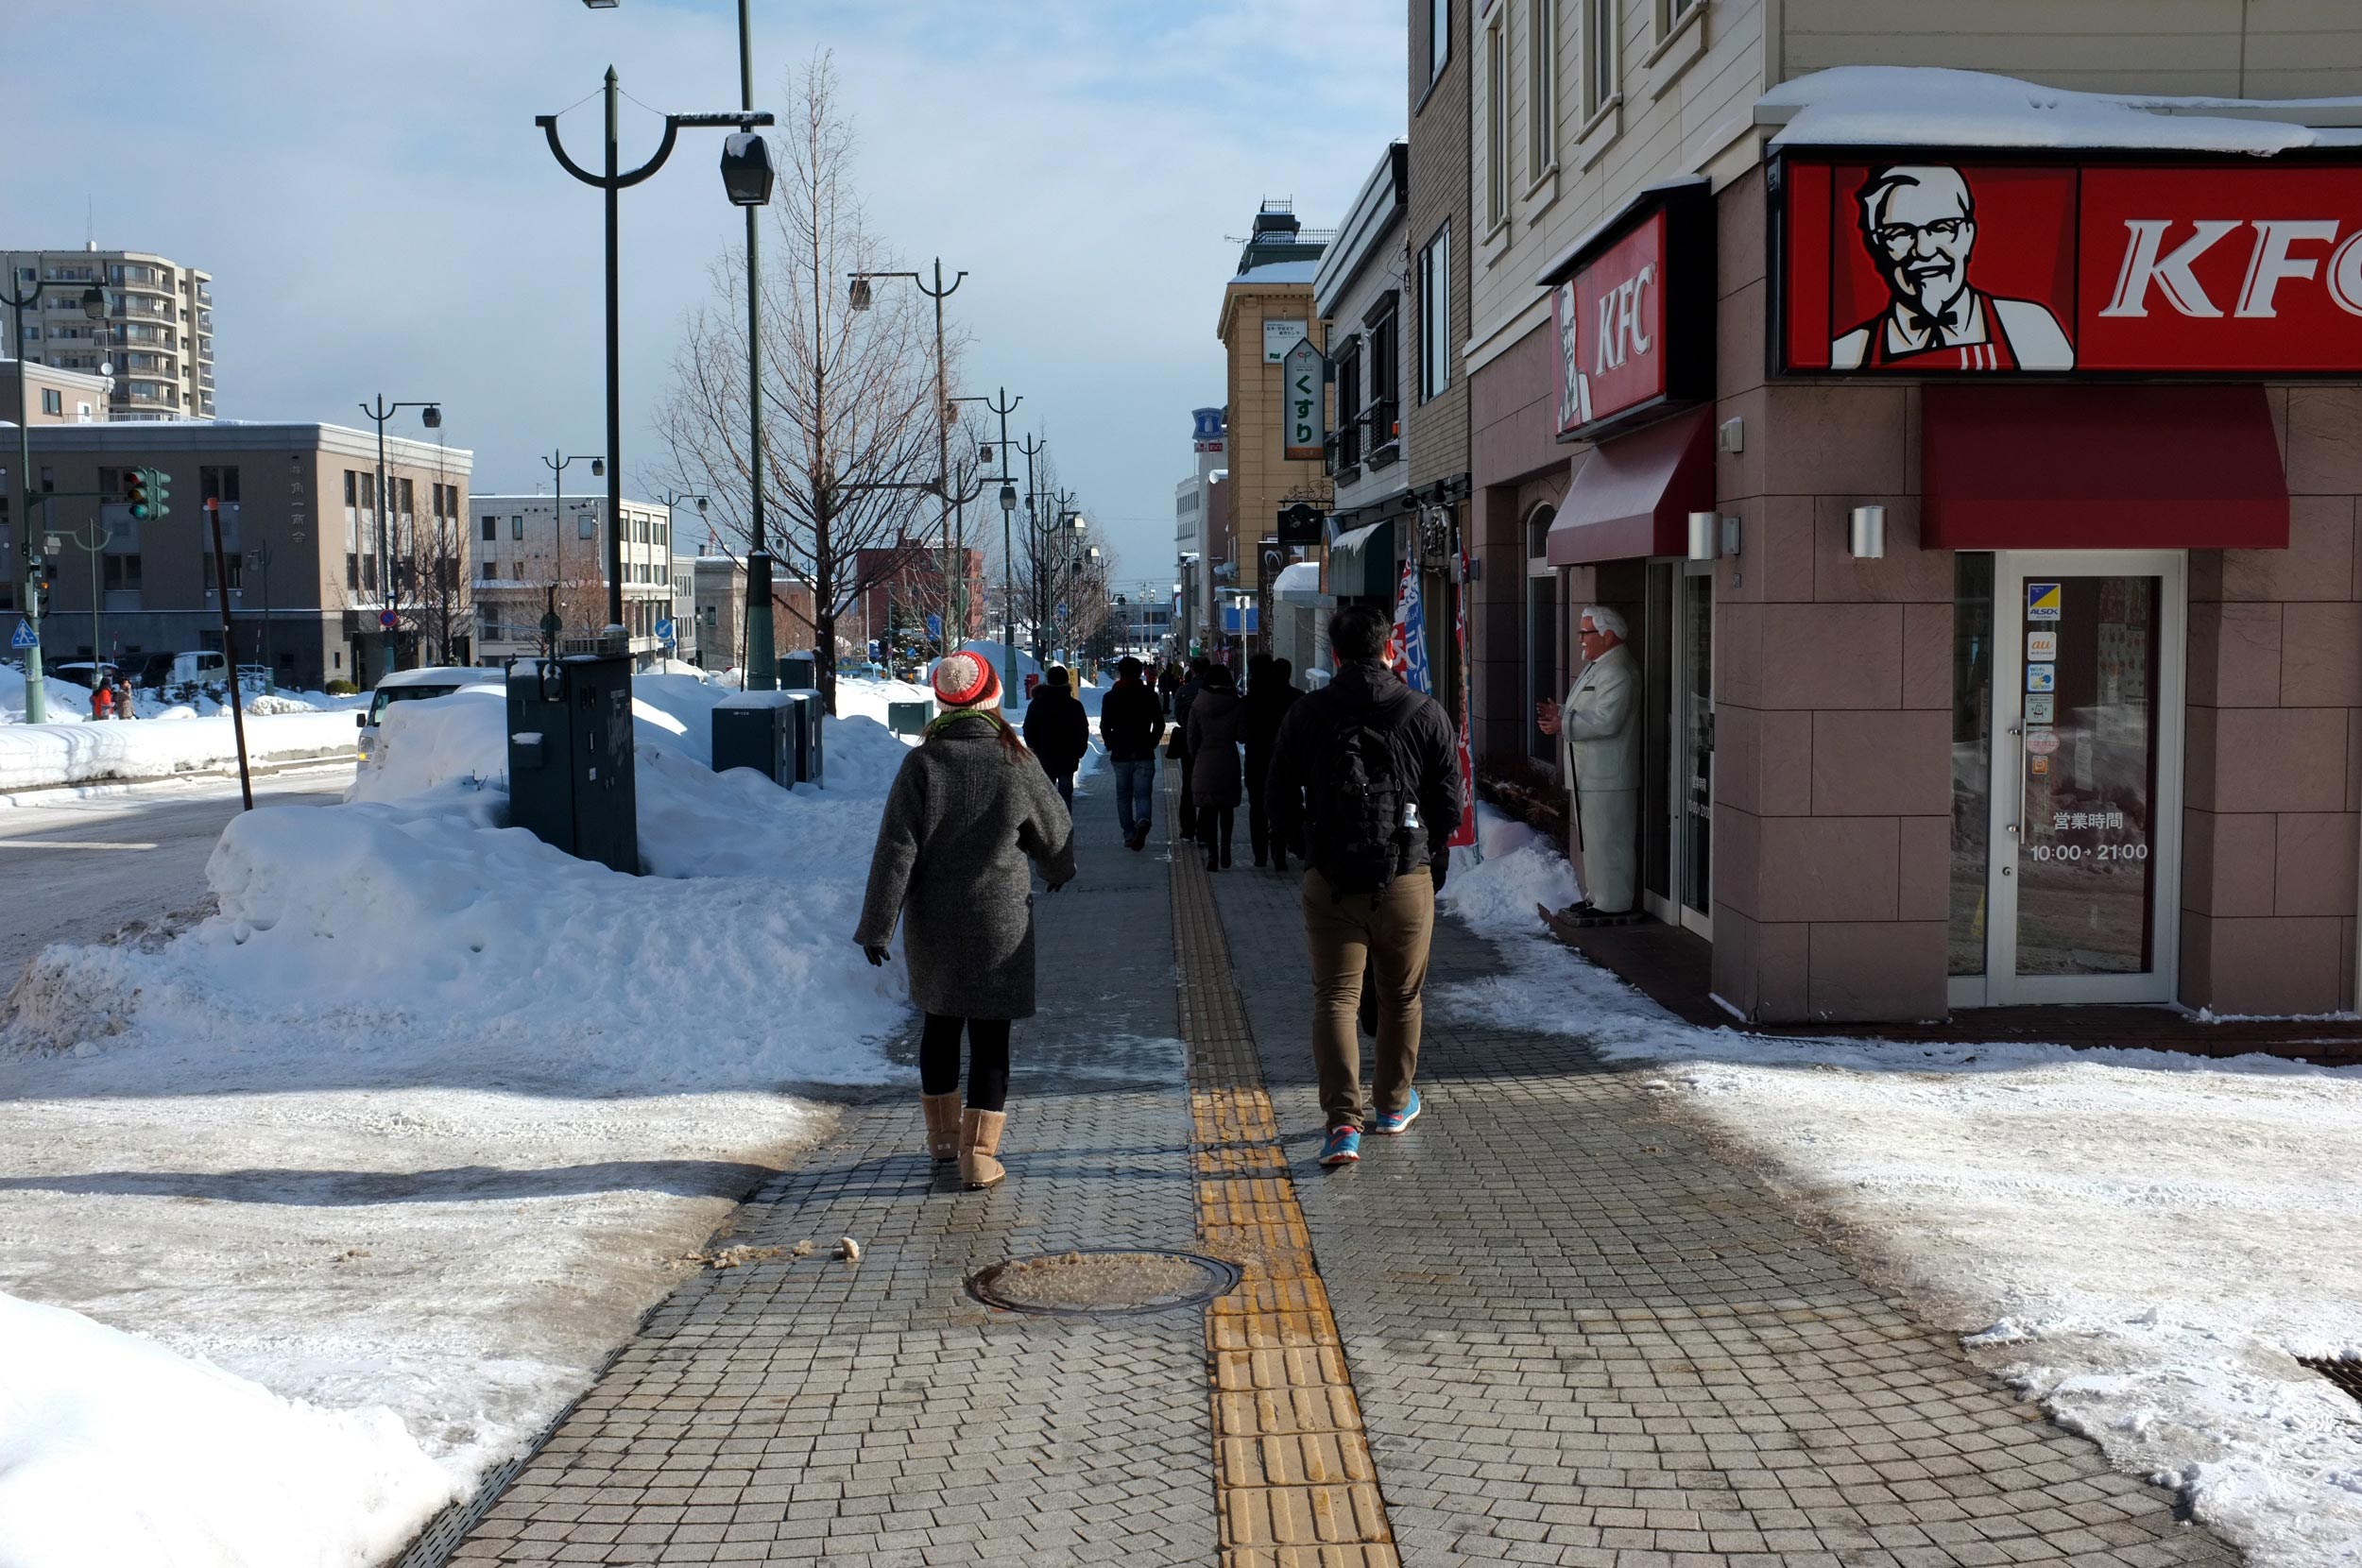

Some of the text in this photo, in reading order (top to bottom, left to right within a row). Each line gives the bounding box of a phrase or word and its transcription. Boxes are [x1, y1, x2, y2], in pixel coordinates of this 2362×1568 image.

[1595, 264, 1653, 377] KFC
[1294, 374, 1314, 443] くすり
[2031, 640, 2052, 650] au
[2053, 812, 2123, 829] 営業時間
[2030, 844, 2148, 861] 10:00 21:00
